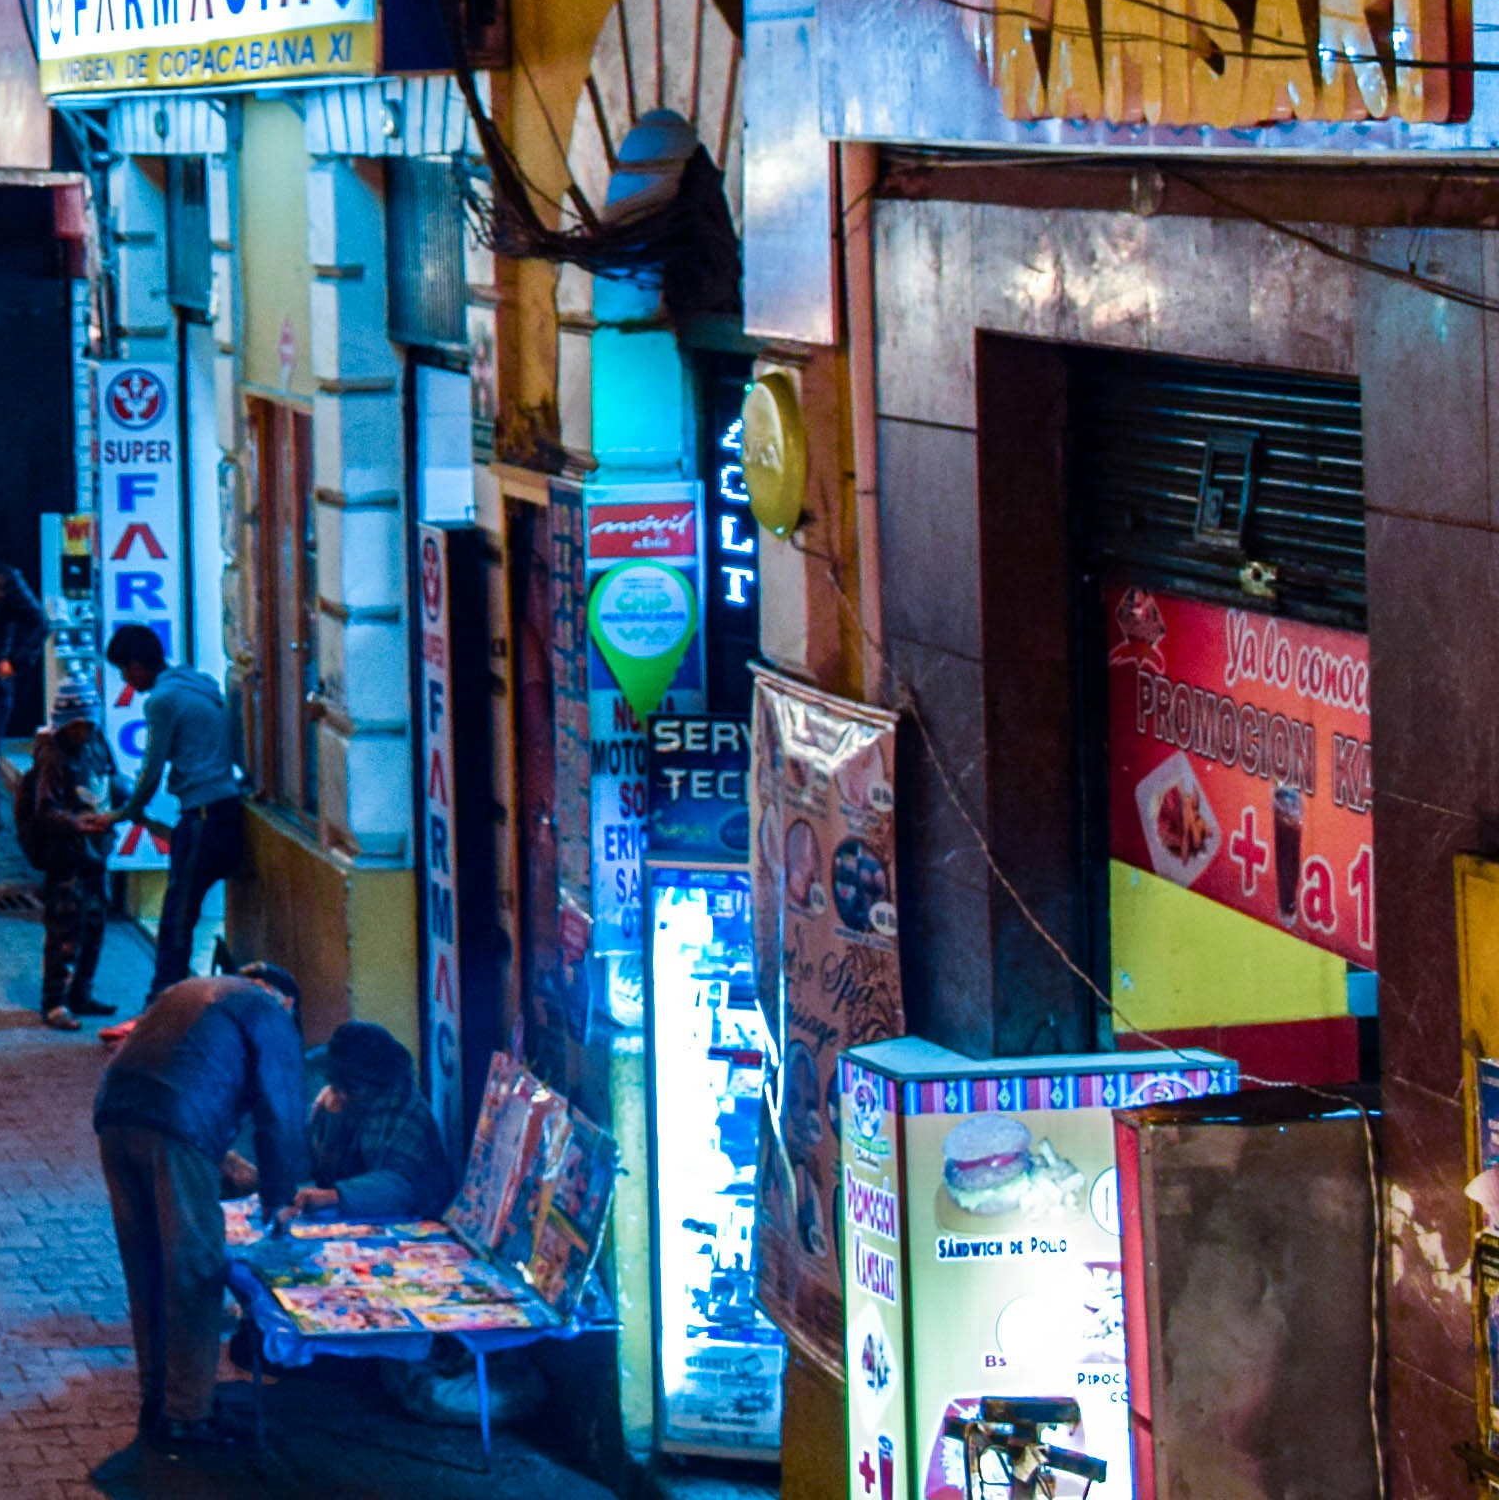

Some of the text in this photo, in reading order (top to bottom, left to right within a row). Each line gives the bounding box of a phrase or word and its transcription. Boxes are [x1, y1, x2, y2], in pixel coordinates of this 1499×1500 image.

[58, 34, 354, 86] VIRGEN DE COPACABANA XI
[104, 438, 173, 465] SUPER
[1225, 608, 1259, 688] Ya
[1263, 616, 1291, 682] lo
[1136, 670, 1315, 796] PROMOCION
